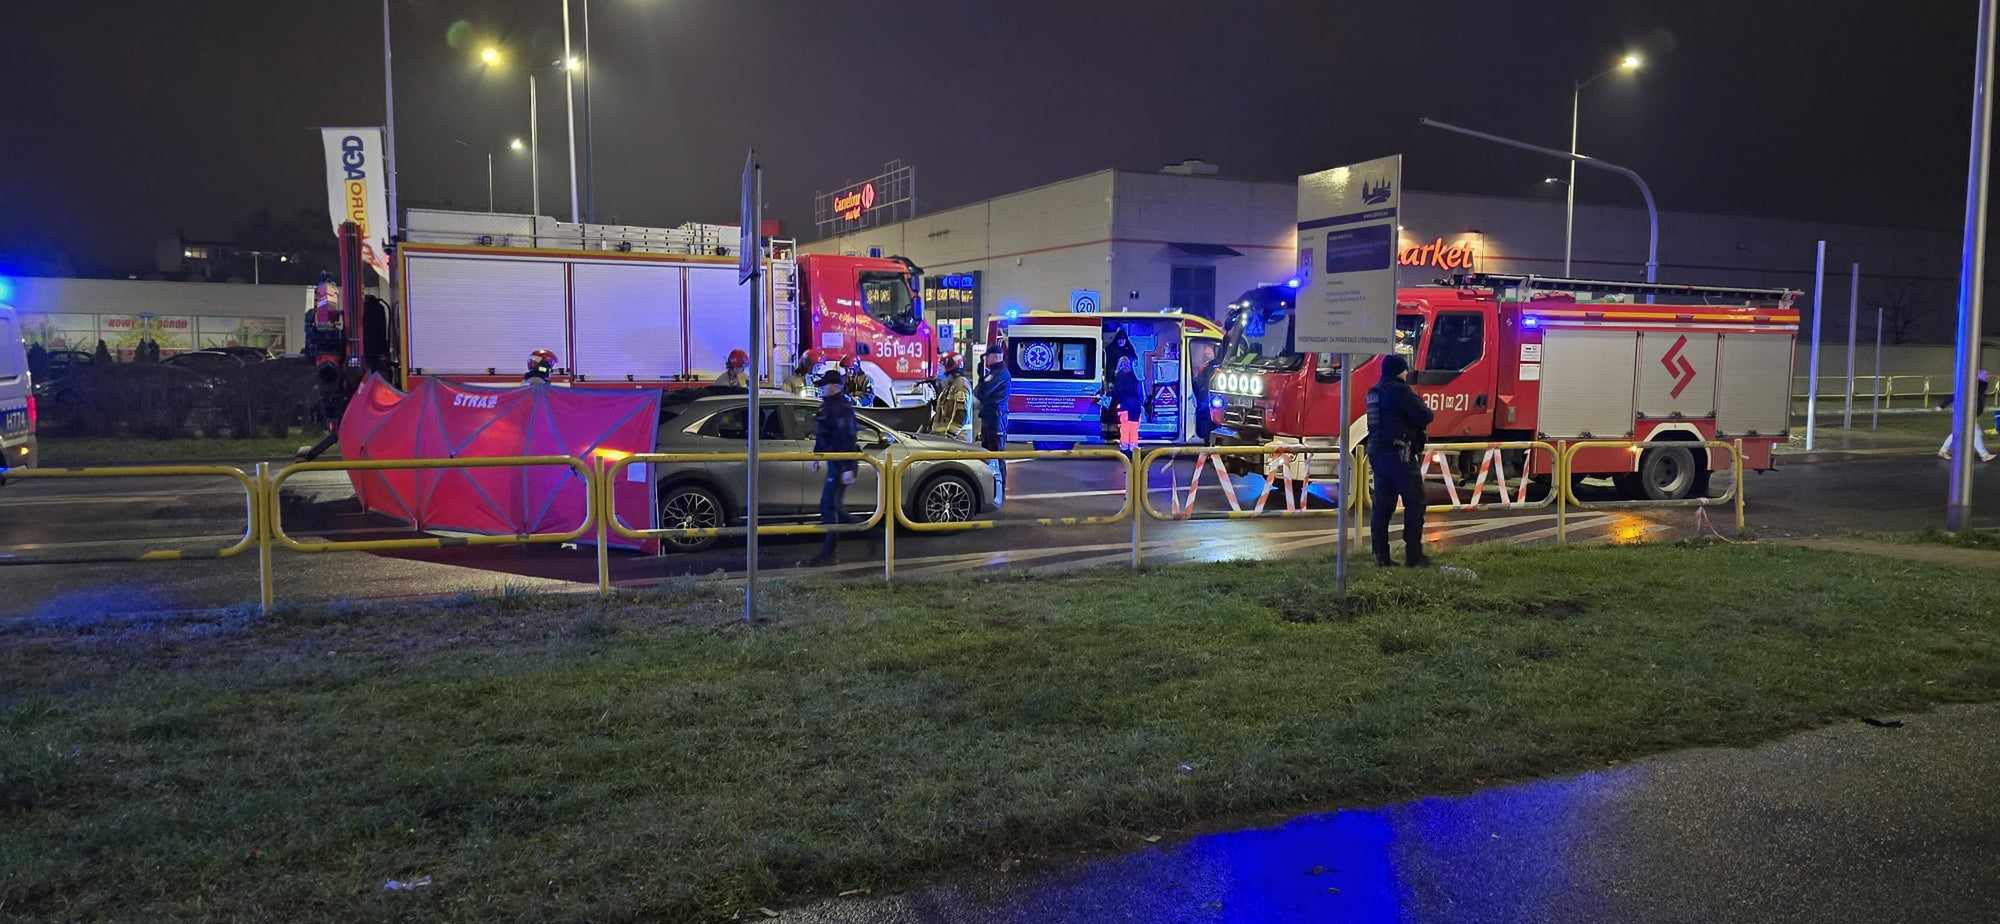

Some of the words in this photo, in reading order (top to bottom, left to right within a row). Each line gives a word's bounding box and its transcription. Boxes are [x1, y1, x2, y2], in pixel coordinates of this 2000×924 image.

[342, 135, 365, 181] AGD
[1397, 237, 1473, 270] arket
[1079, 302, 1093, 313] 20
